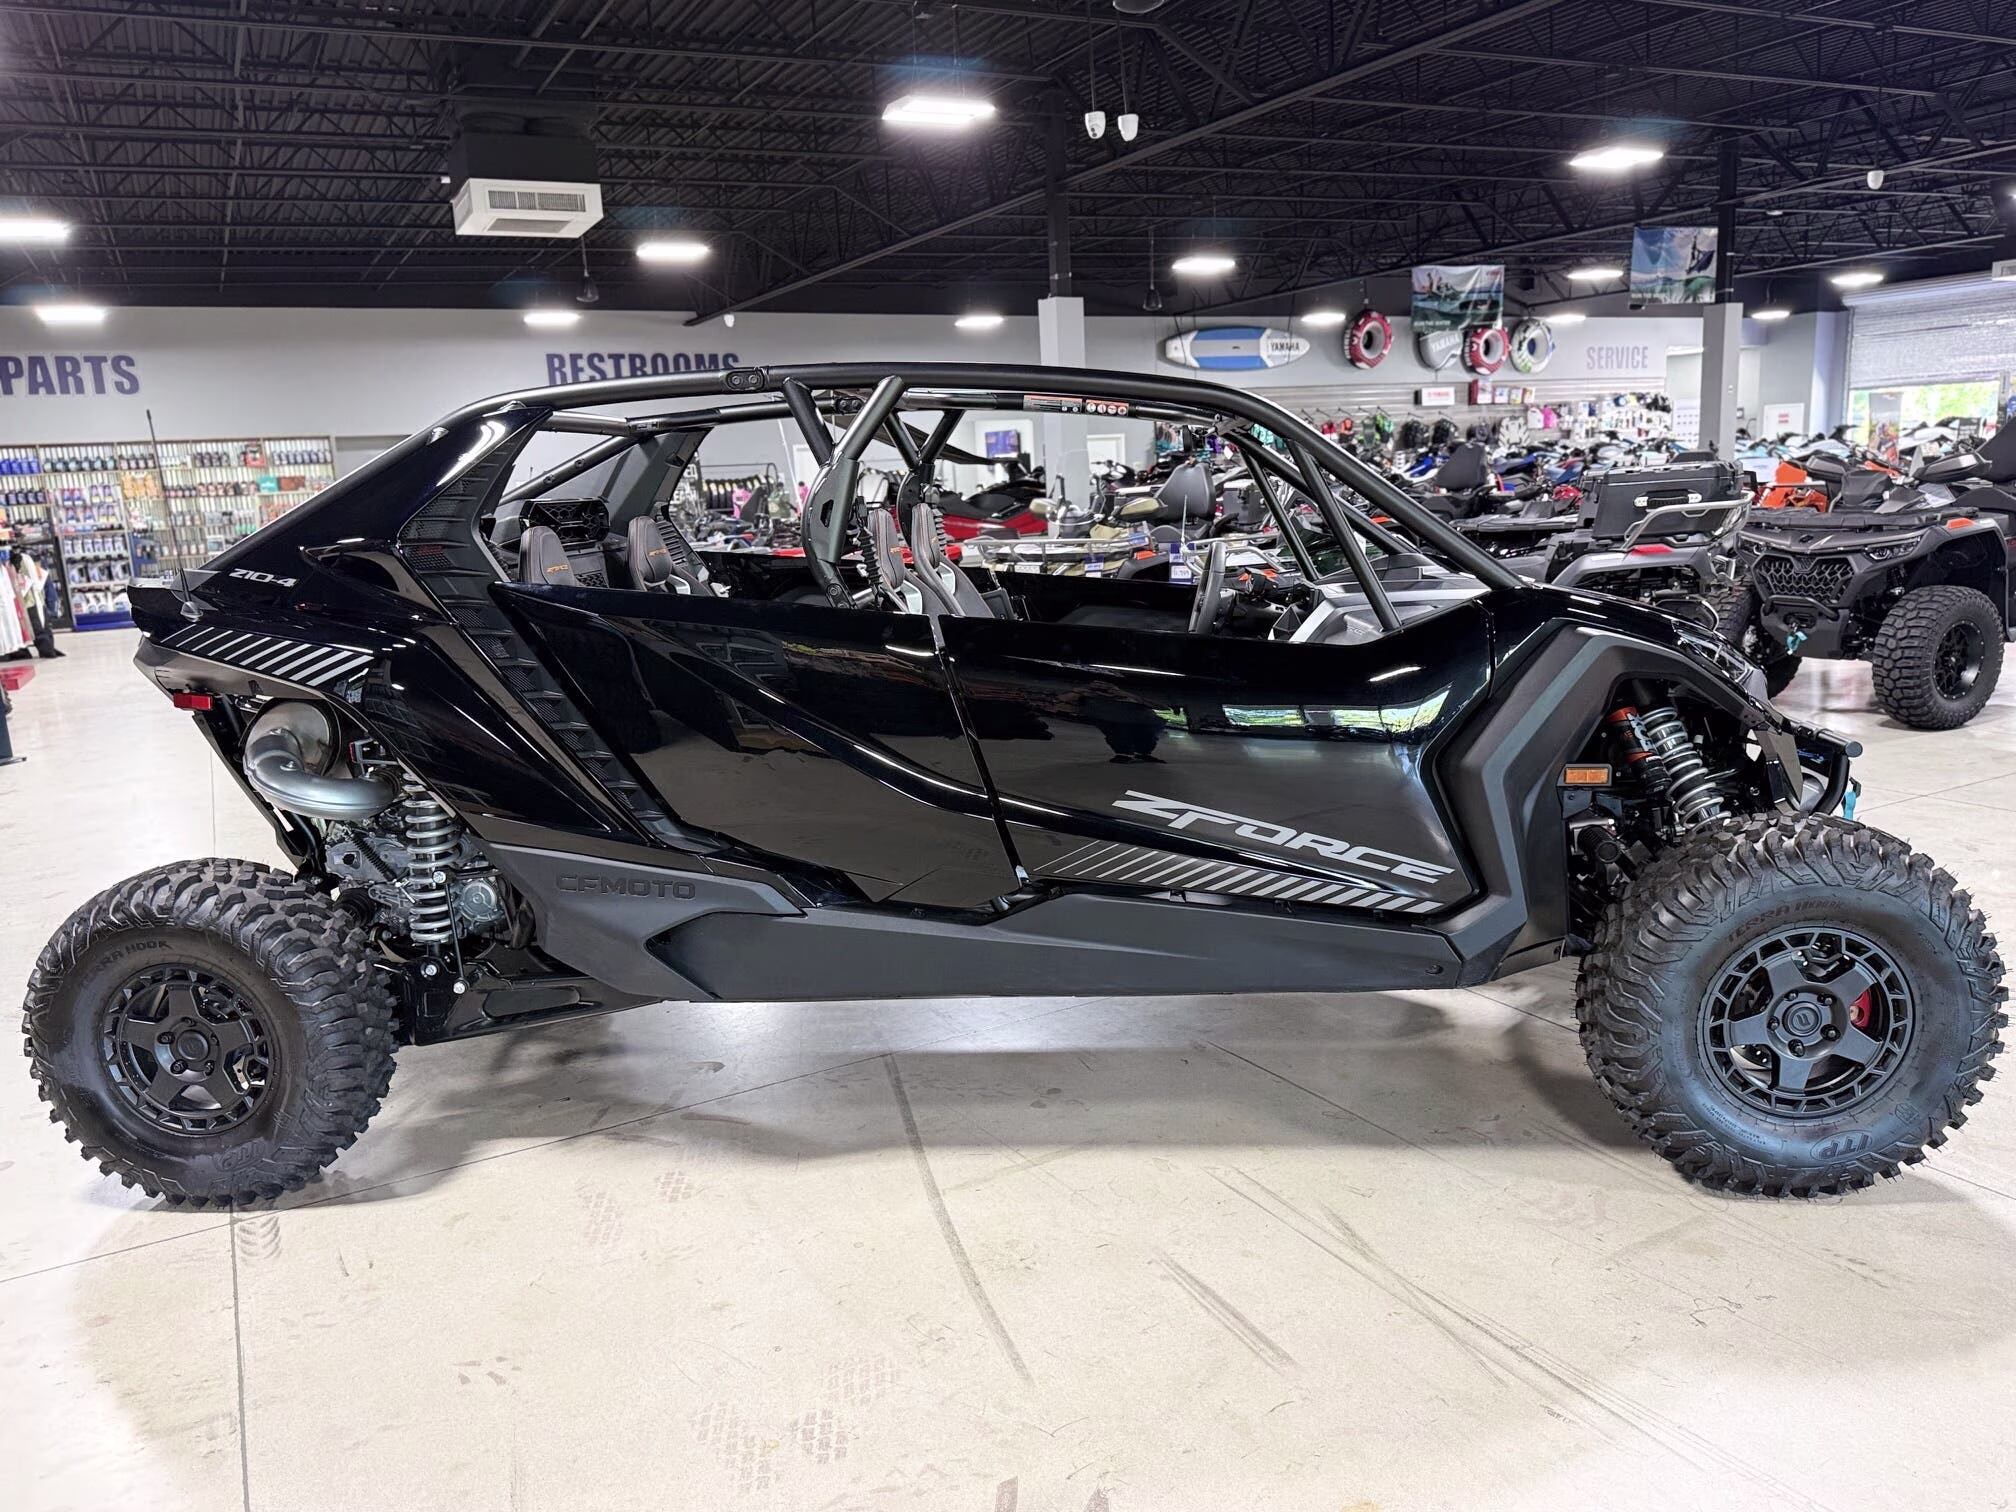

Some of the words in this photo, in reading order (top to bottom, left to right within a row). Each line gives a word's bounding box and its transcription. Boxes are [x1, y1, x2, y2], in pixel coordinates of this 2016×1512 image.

[1271, 342, 1299, 351] YAMAHA
[1586, 346, 1649, 369] SERVICE
[0, 355, 140, 395] PARTS
[1111, 789, 1455, 884] ZFORCE
[556, 873, 696, 900] CFMOTO
[125, 940, 173, 954] HOOK
[1818, 1134, 1871, 1160] ITP
